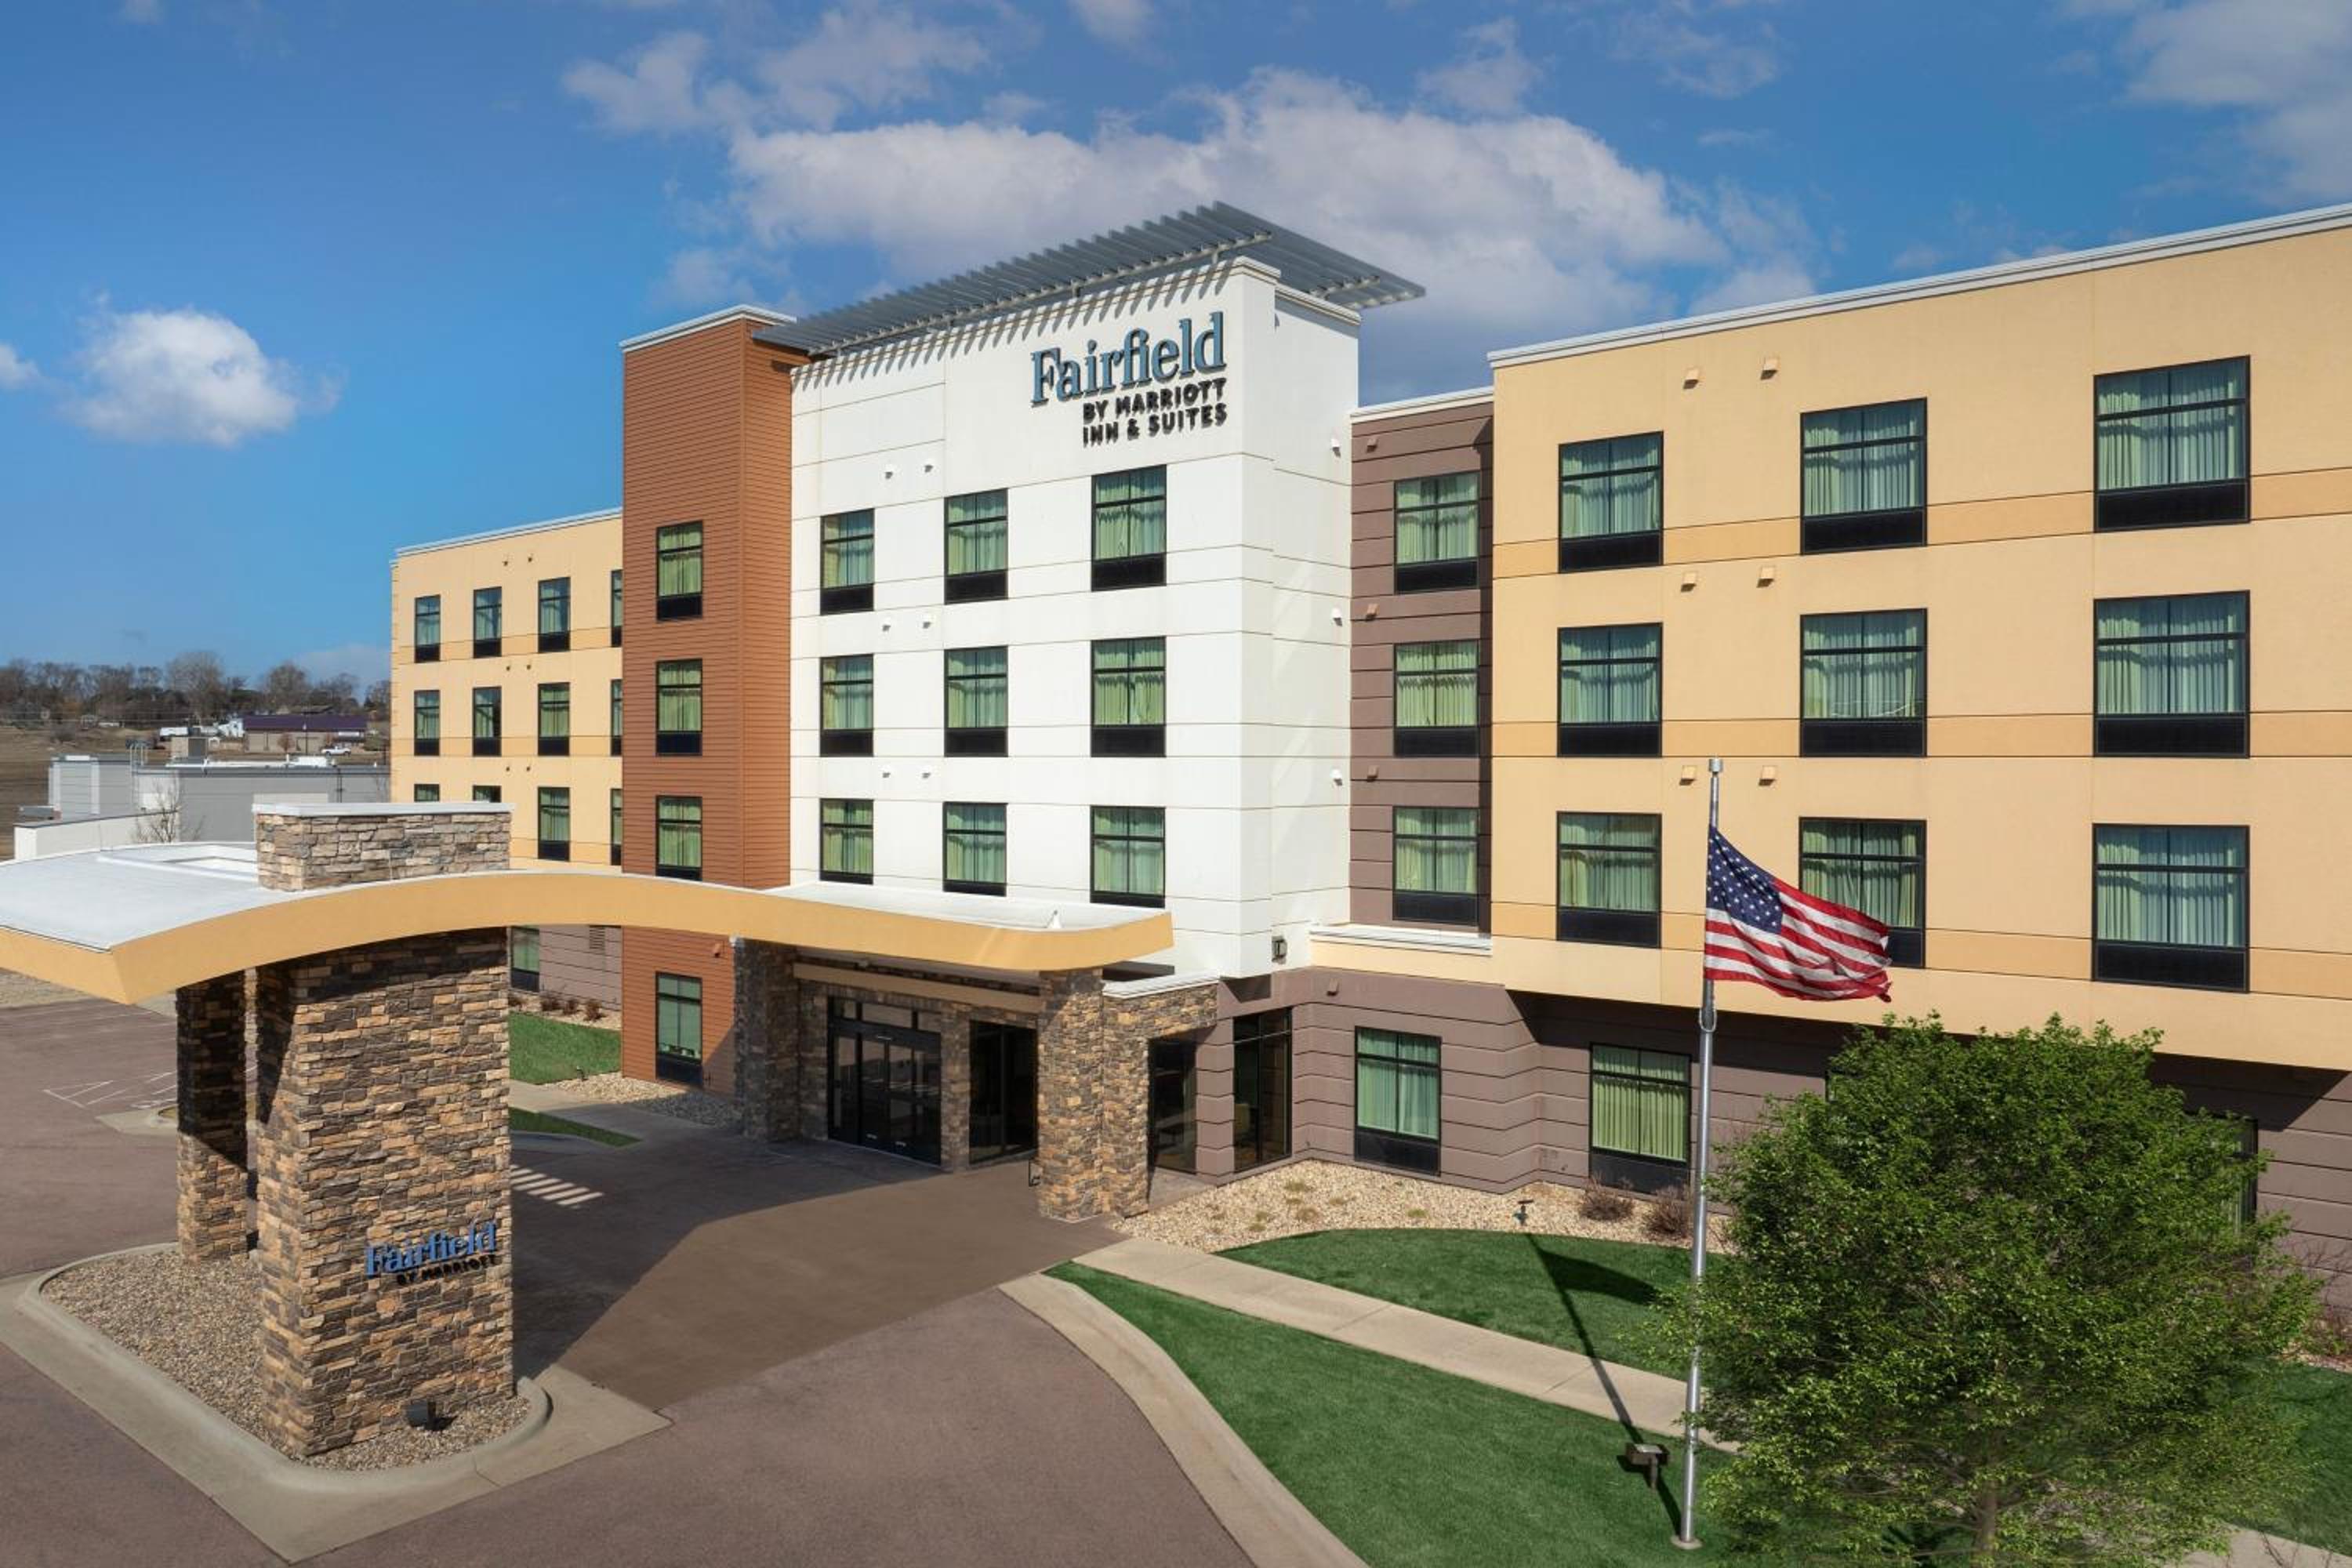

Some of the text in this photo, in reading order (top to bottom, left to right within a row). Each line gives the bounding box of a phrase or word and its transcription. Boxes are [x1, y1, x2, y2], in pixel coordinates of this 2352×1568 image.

[1030, 311, 1227, 406] Fairfield
[1083, 378, 1226, 423] BY MARRIOTT
[1083, 403, 1227, 447] INN & SUITES
[365, 1221, 496, 1279] Fairfield
